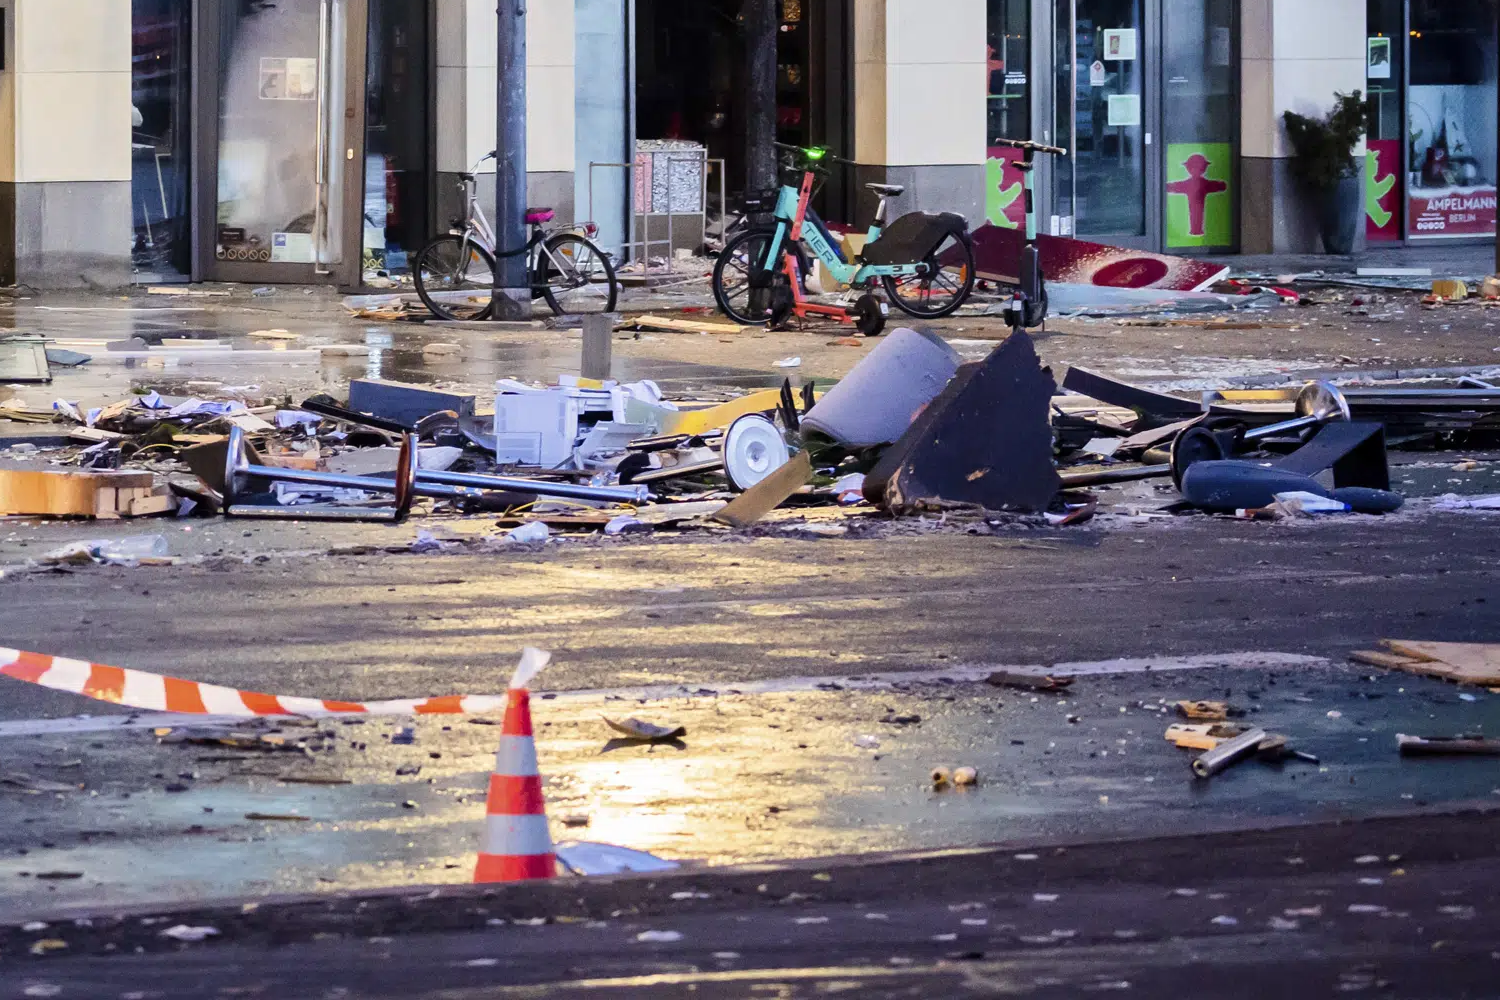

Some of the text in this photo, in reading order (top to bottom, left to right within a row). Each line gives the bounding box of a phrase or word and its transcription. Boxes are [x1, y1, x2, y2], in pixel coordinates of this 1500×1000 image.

[1427, 198, 1497, 211] AMPELMANN
[1449, 214, 1476, 222] BERLIN
[804, 224, 834, 264] TIER
